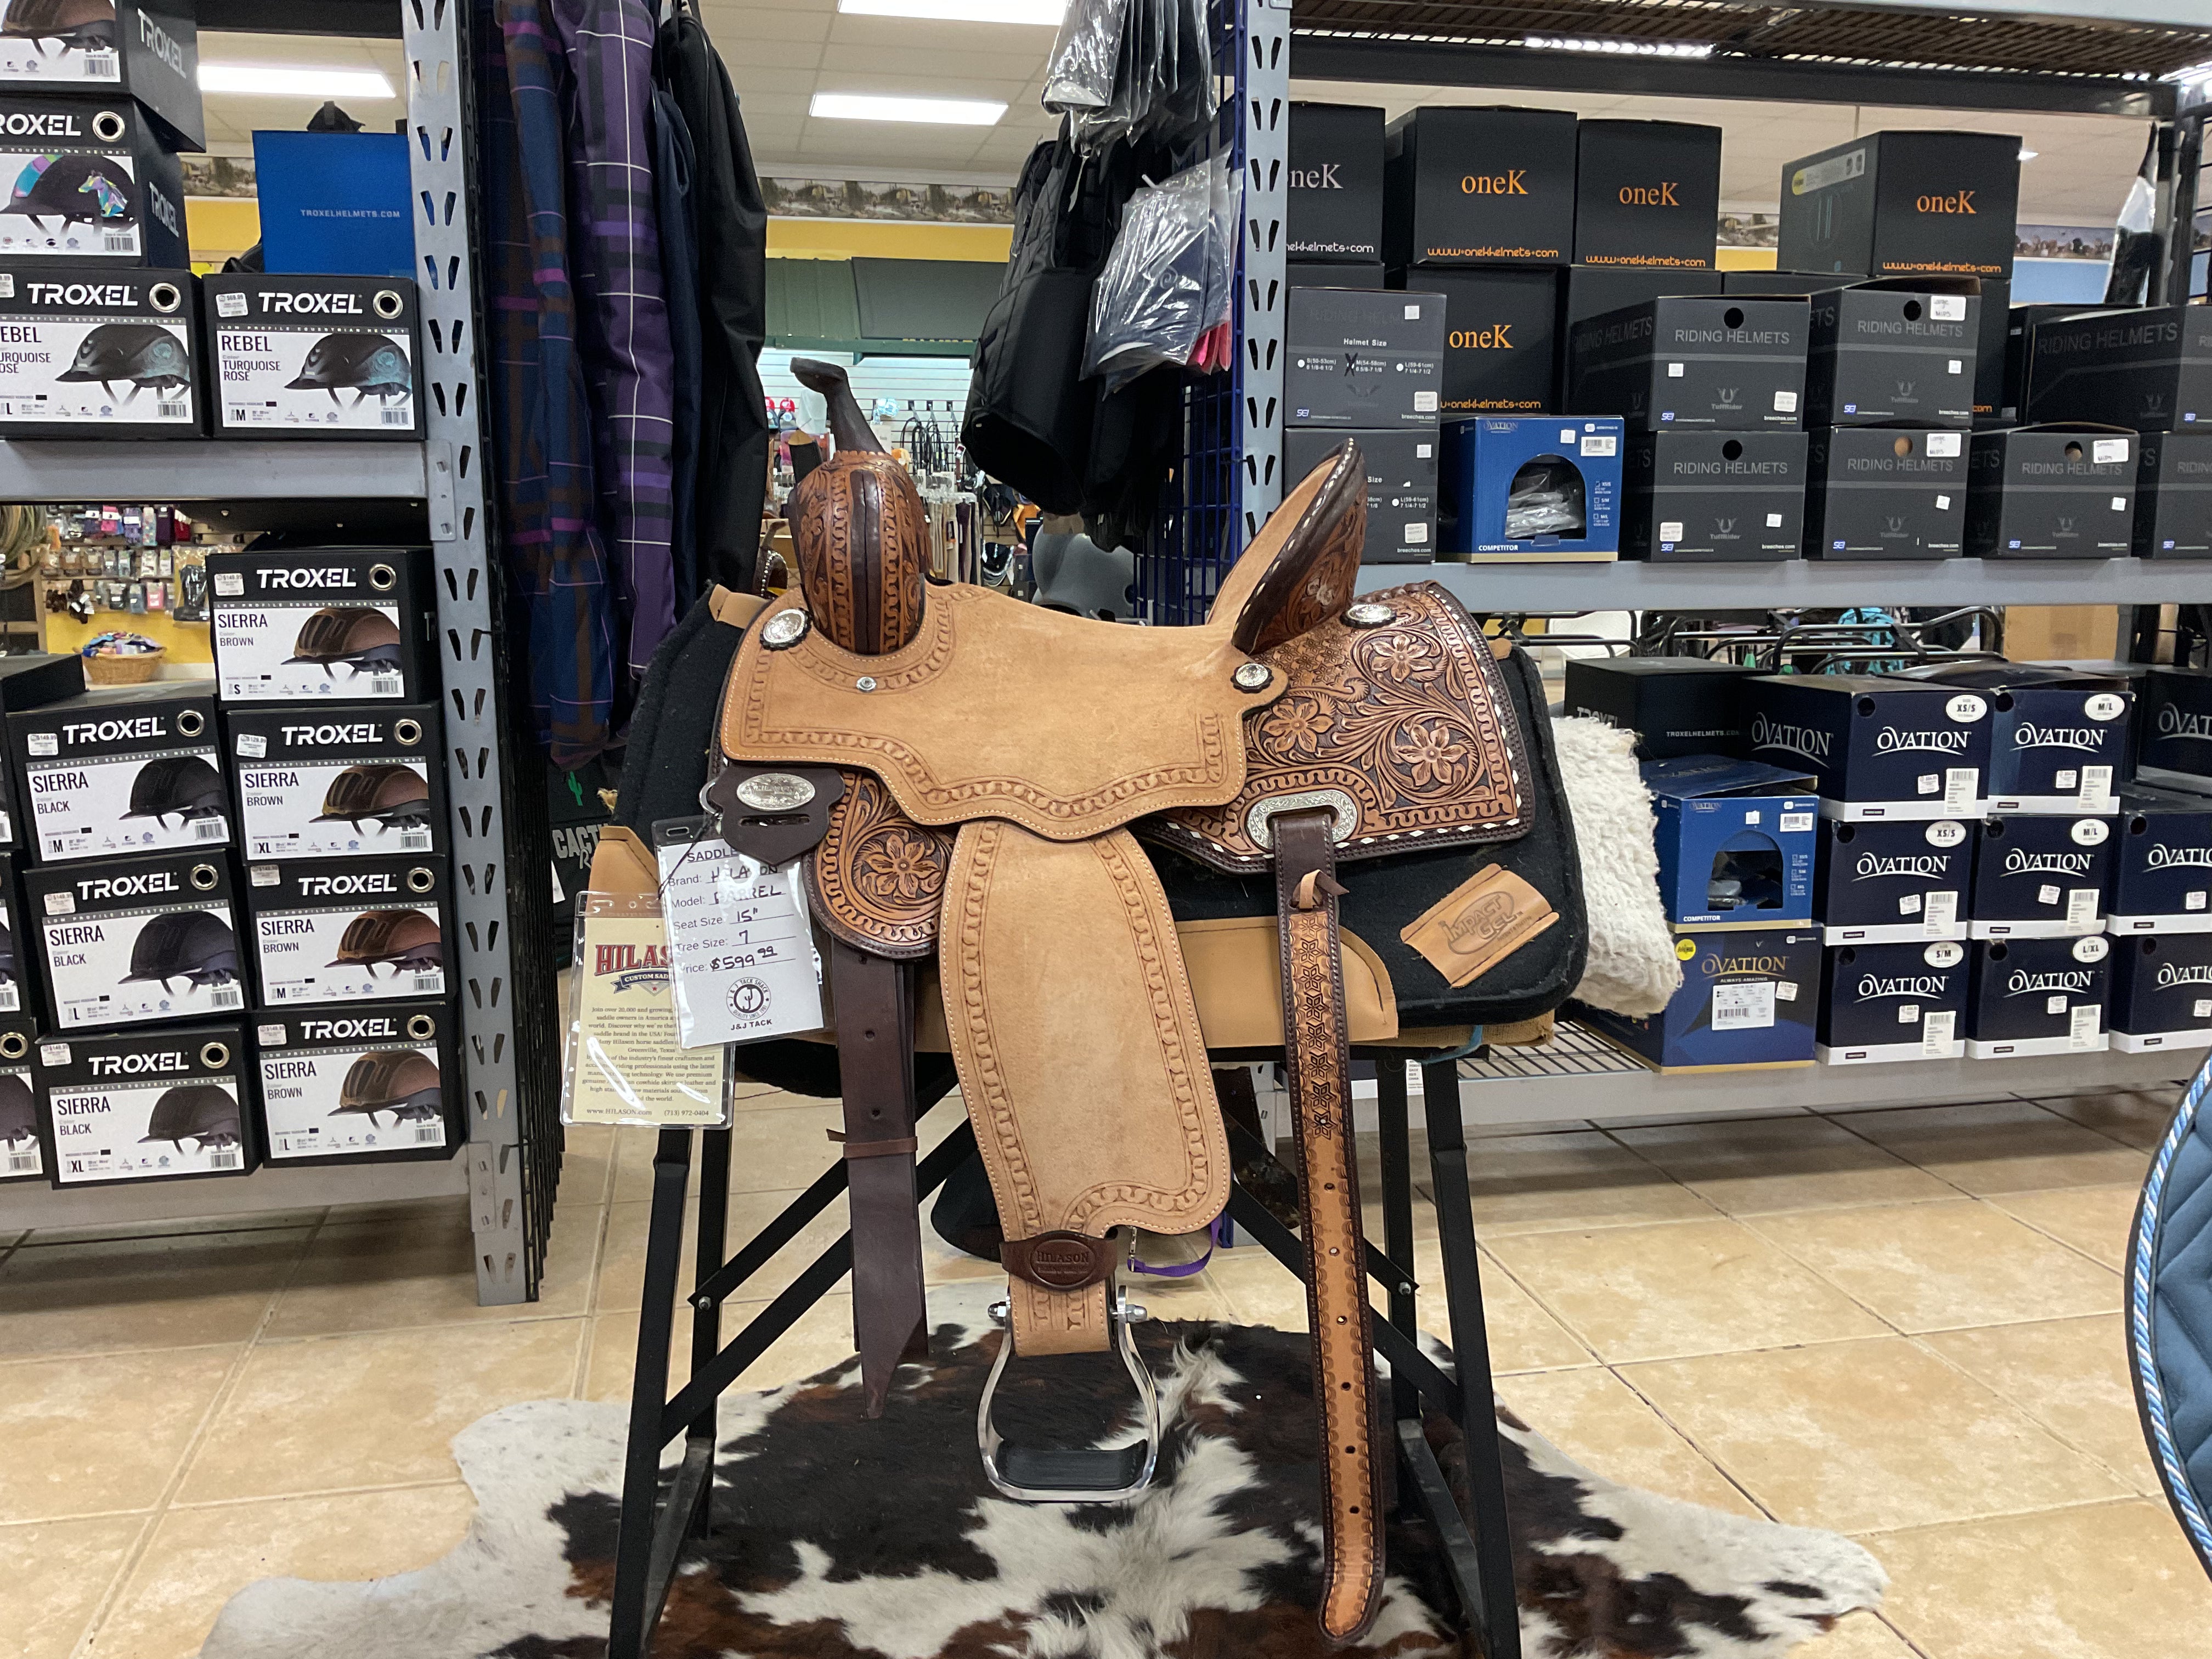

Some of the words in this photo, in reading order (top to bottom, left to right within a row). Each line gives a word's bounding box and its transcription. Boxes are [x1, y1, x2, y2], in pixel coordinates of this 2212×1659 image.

[138, 8, 186, 79] TROXEL
[0, 114, 81, 137] OXEL
[1288, 164, 1343, 188] neK
[1462, 170, 1528, 195] oneK
[1619, 182, 1679, 206] oneK
[1917, 190, 1976, 214] oneK
[149, 182, 179, 238] TROXEL
[301, 209, 400, 218] TROXELHELMETS.COM
[27, 283, 138, 306] TROXEL
[258, 292, 363, 314] TROXEL
[0, 326, 42, 343] EBEL
[1449, 324, 1513, 348] oneK
[1675, 330, 1722, 343] RIDING
[1727, 331, 1790, 345] HELMETS
[1858, 320, 1901, 335] RIDING
[1906, 323, 1963, 338] HELMETS
[2096, 323, 2178, 349] HELMETS
[222, 335, 272, 351] REBEL
[1344, 338, 1369, 346] Helmet
[223, 360, 281, 371] TURQUOISE
[223, 371, 250, 381] ROSE
[236, 409, 246, 421] M
[1674, 462, 1720, 474] RIDING
[1725, 462, 1788, 474] HELMETS
[1848, 459, 1893, 471] RIDING
[1897, 459, 1953, 472] HELMETS
[2022, 462, 2064, 475] RIDING
[2067, 463, 2122, 476] HELMETS
[257, 568, 357, 589] TROXEL
[218, 614, 268, 628] SIERRA
[220, 637, 253, 646] BROWN
[63, 717, 166, 744] TROXEL
[281, 724, 383, 746] TROXEL
[1752, 712, 1832, 756] OVATION
[1877, 726, 1968, 749] OVATION
[2016, 723, 2104, 745] OVATION
[32, 771, 89, 793] SIERRA
[245, 772, 300, 788] SIERRA
[37, 801, 70, 814] BLACK
[247, 796, 283, 806] BROWN
[53, 839, 63, 853] M
[258, 842, 272, 854] XL
[687, 849, 738, 862] SADDLE
[1857, 852, 1948, 874] OVATION
[2006, 848, 2091, 871] OVATION
[77, 872, 179, 900] TROXEL
[298, 873, 397, 896] TROXEL
[669, 876, 702, 887] Brand:
[672, 896, 705, 908] Model:
[261, 919, 314, 936] SIERRA
[674, 921, 697, 930] Seat
[49, 925, 105, 946] SIERRA
[703, 939, 728, 949] Size:
[263, 942, 299, 953] BROWN
[54, 953, 86, 967] BLACK
[1702, 953, 1786, 974] OVATION
[624, 973, 654, 982] CUSTOM
[1858, 974, 1946, 996] OVATION
[2009, 969, 2091, 992] OVATION
[277, 988, 286, 998] M
[301, 1018, 397, 1039] TROXEL
[749, 1019, 772, 1028] TACK
[88, 1052, 189, 1075] TROXEL
[265, 1062, 317, 1080] SIERRA
[267, 1087, 302, 1099] BROWN
[58, 1097, 111, 1115] SIERRA
[60, 1123, 91, 1136] BLACK
[71, 1160, 83, 1173] XL
